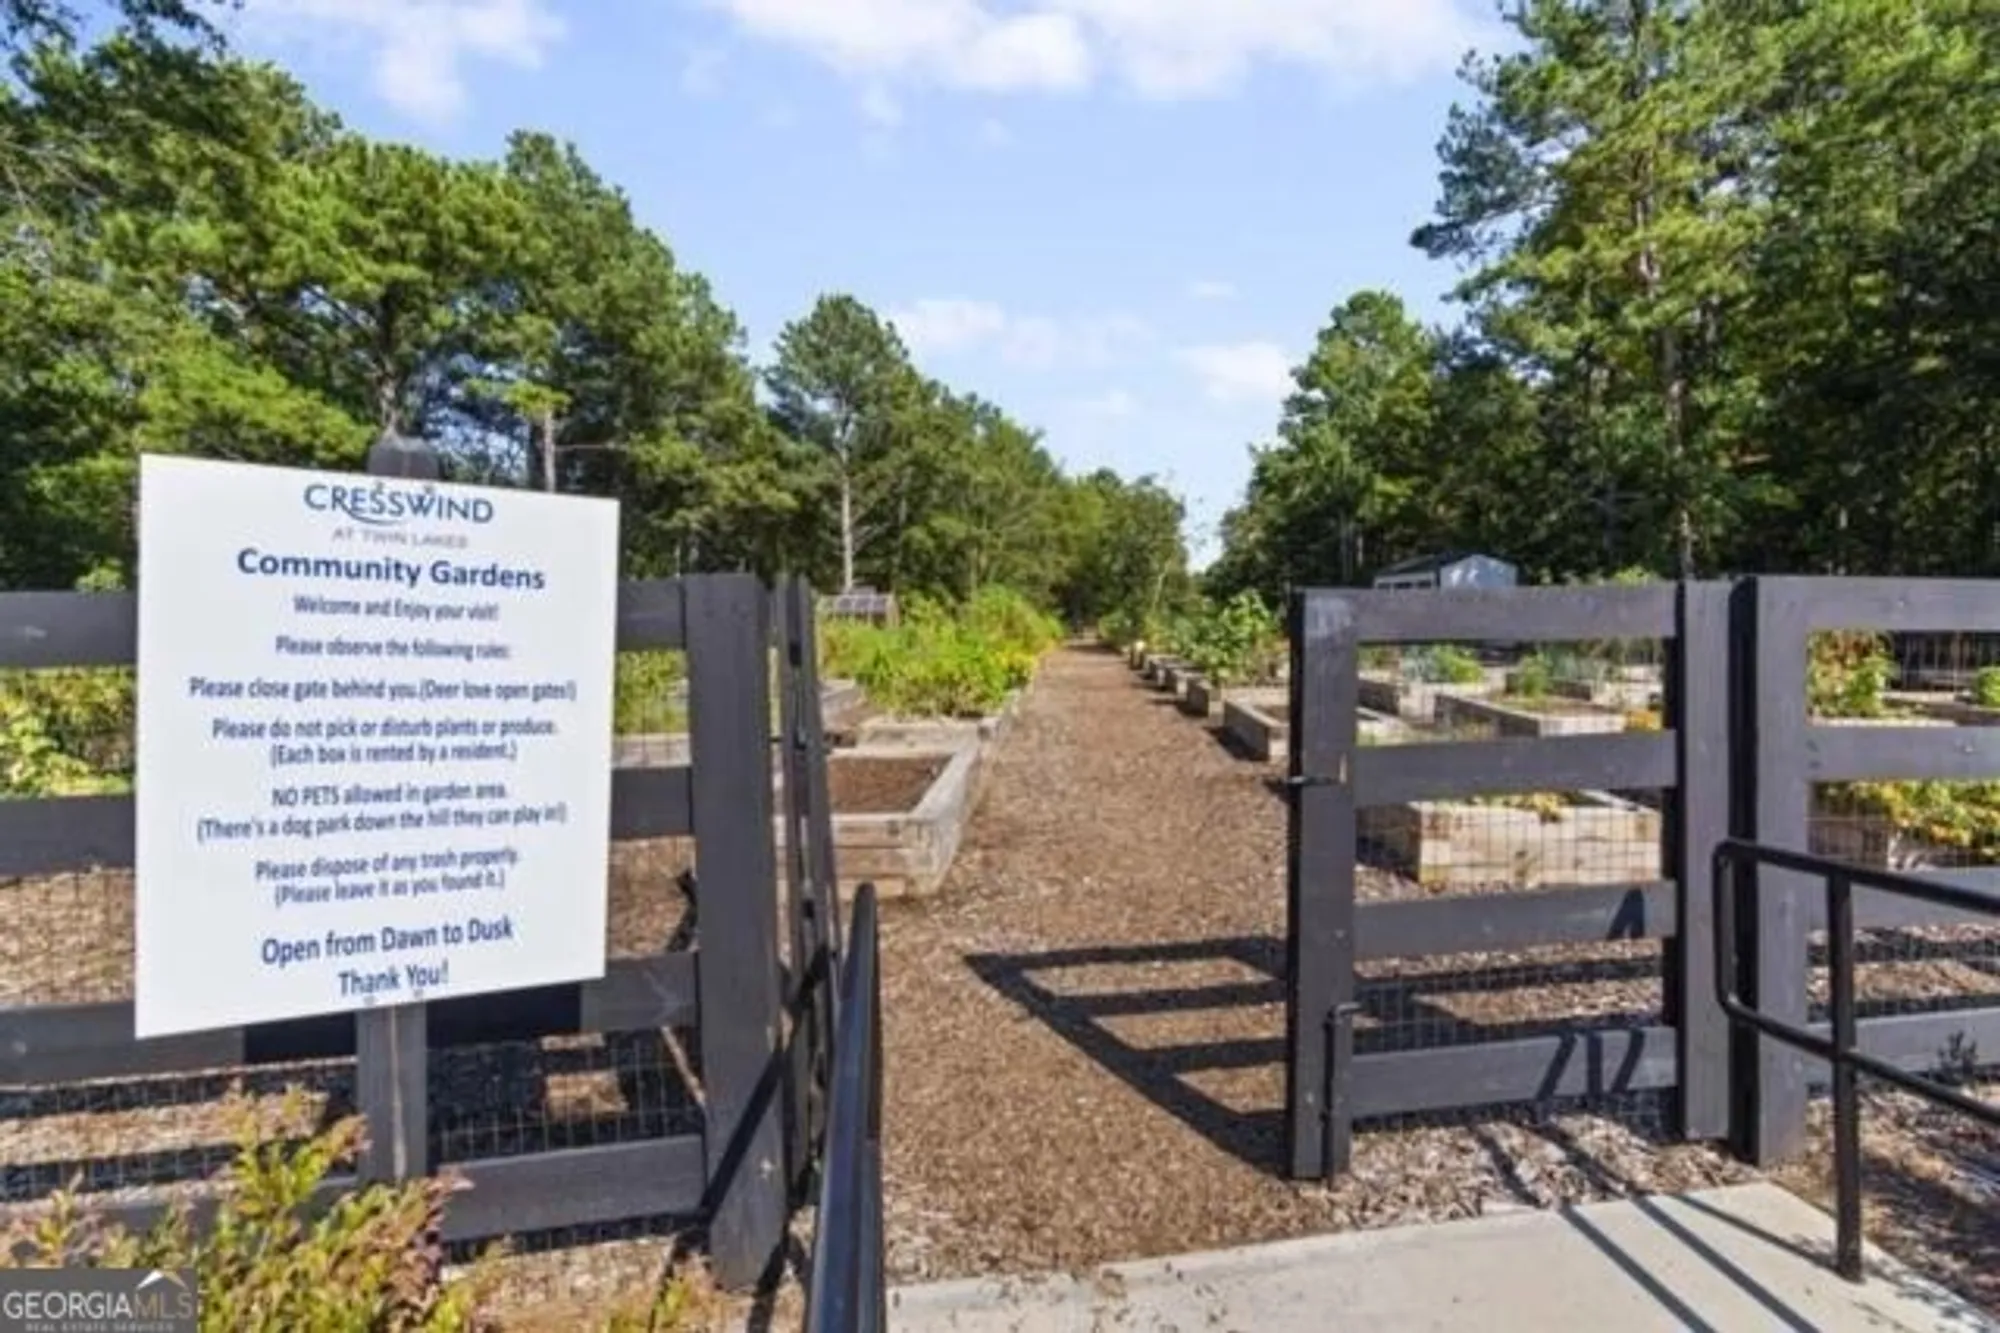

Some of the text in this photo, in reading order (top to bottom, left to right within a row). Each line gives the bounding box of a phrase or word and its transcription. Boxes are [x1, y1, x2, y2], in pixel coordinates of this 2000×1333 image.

[303, 483, 493, 525] CRESSWIND
[332, 527, 467, 548] AT TWIN LAKES
[237, 548, 545, 589] Community Gardens
[293, 595, 360, 615] Welcome
[365, 598, 390, 616] and
[395, 599, 430, 620] Enjoy
[435, 603, 464, 621] your
[276, 635, 322, 655] Please
[326, 635, 382, 656] observe
[386, 639, 408, 656] the
[412, 638, 474, 662] following
[189, 677, 242, 697] Please
[248, 678, 289, 698] close
[295, 680, 327, 702] gate
[332, 679, 385, 699] behind
[463, 680, 490, 699] love
[495, 684, 528, 702] open
[212, 717, 265, 738] Please
[269, 717, 291, 737] do
[295, 719, 321, 737] not
[326, 718, 356, 740] pick
[360, 722, 376, 737] or
[379, 717, 432, 736] disturb
[436, 716, 477, 738] plants
[482, 720, 496, 735] or
[269, 743, 314, 768] (Each
[318, 745, 345, 763] box
[351, 744, 361, 763] is
[366, 744, 414, 762] rented
[418, 743, 435, 766] by
[438, 746, 448, 761] a
[272, 786, 298, 806] NO
[303, 785, 339, 806] PETS
[344, 782, 401, 804] allowed
[405, 782, 420, 801] in
[423, 782, 471, 805] garden
[198, 816, 264, 843] (There's
[268, 821, 279, 836] a
[282, 815, 311, 838] dog
[316, 813, 349, 837] park
[354, 811, 395, 832] down
[400, 810, 423, 829] the
[427, 808, 449, 827] hill
[453, 806, 483, 828] they
[487, 808, 511, 823] can
[513, 804, 541, 826] play
[255, 861, 307, 881] Please
[311, 857, 368, 878] dispose
[373, 853, 390, 873] of
[392, 856, 417, 873] any
[422, 849, 457, 869] trash
[276, 882, 332, 909] (Please
[336, 879, 375, 901] leave
[380, 879, 389, 896] it
[393, 881, 408, 895] as
[412, 879, 438, 898] you
[442, 871, 482, 891] found
[262, 915, 513, 968] Open from Dawn to Dusk
[337, 961, 449, 996] Thank You!
